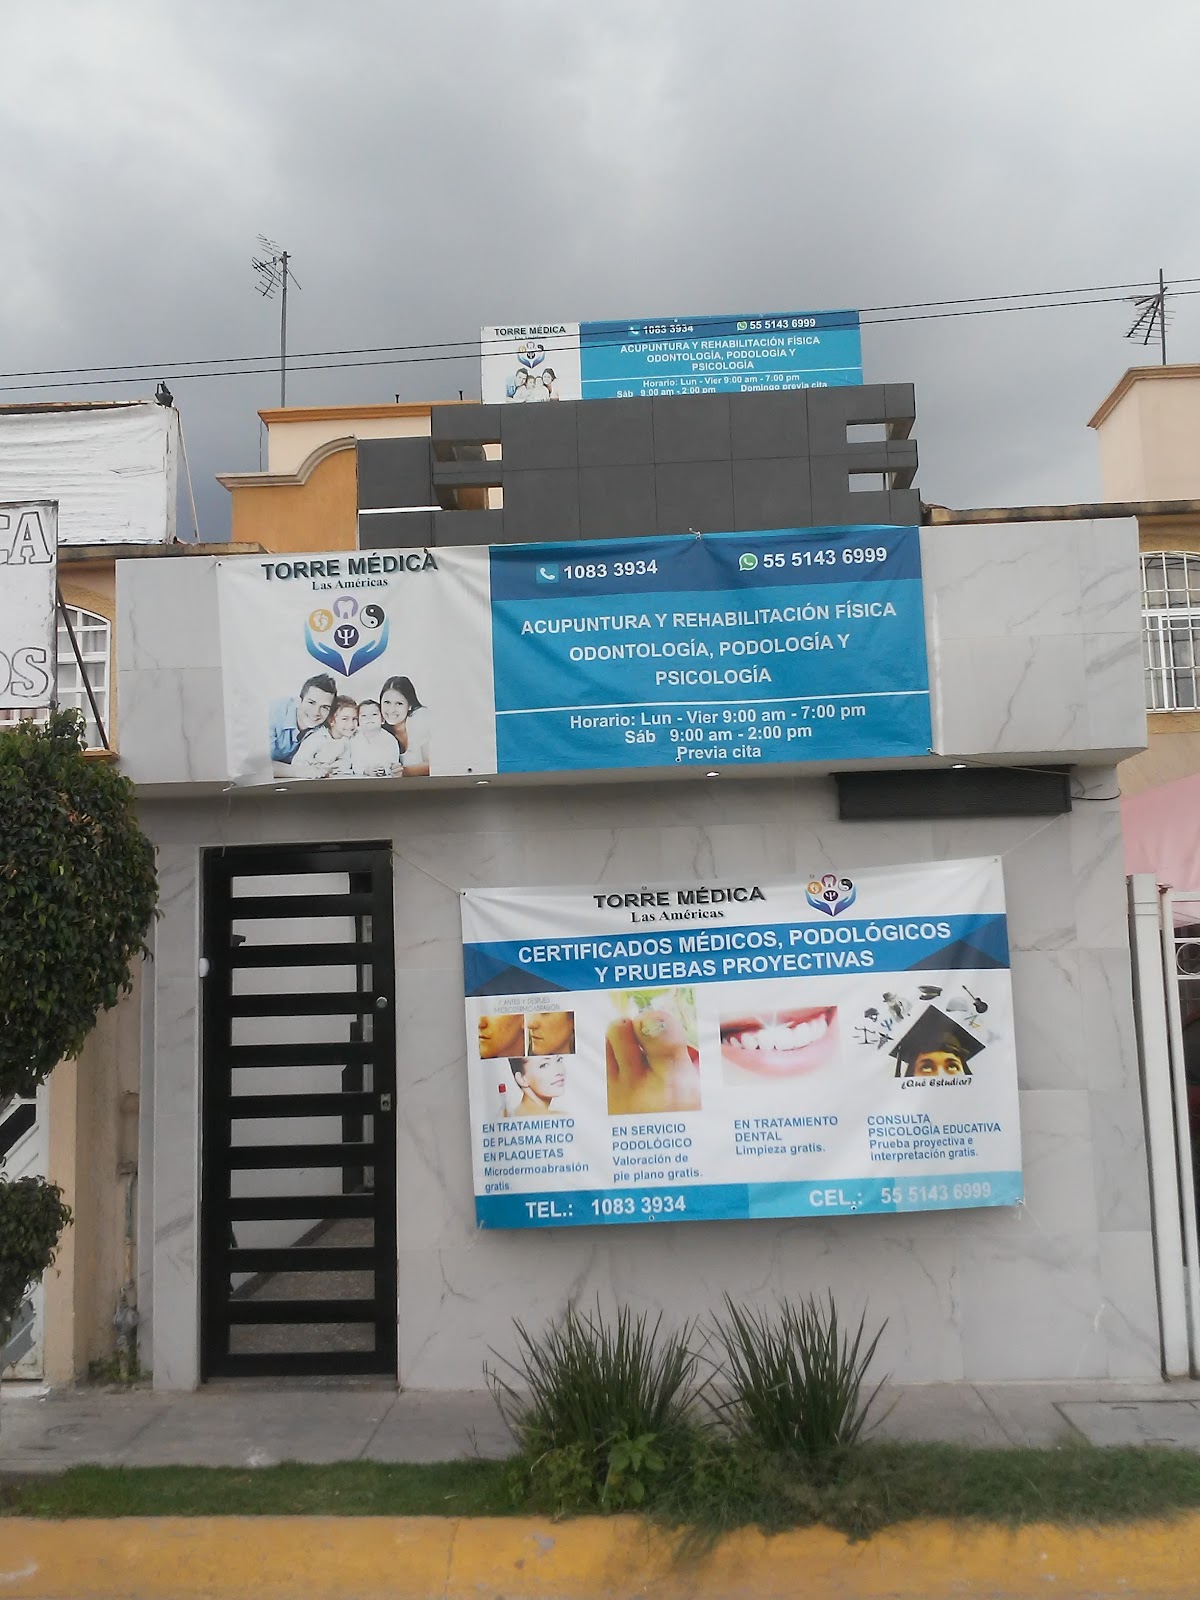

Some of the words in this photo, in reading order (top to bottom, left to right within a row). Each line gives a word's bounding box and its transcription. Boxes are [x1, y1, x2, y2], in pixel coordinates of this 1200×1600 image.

[494, 327, 527, 336] TORRE
[529, 325, 566, 335] MÉDICA
[643, 325, 667, 335] 1083
[669, 324, 694, 333] 3934
[750, 321, 762, 330] 55
[764, 320, 789, 329] 5143
[791, 318, 816, 328] 6999
[620, 342, 690, 354] ACUPUNTURA
[691, 341, 698, 350] Y
[701, 336, 785, 349] REHABILITACIÓN
[787, 335, 821, 345] FÍSICA
[647, 352, 724, 363] ODONTOLOGÍA,
[726, 349, 787, 359] PODOLOGÍA
[788, 348, 796, 357] Y
[692, 360, 754, 371] PSICOLOGÍA
[643, 379, 678, 388] Horario:
[680, 378, 697, 386] Lun
[705, 376, 721, 384] Vier
[724, 375, 743, 384] 9:00
[765, 374, 784, 382] 7:00
[786, 375, 800, 383] pm
[616, 390, 634, 398] Sáb
[681, 387, 700, 395] 2:00
[763, 552, 786, 569] 55
[791, 549, 837, 567] 5143
[842, 547, 888, 565] 6999
[261, 558, 341, 580] TORRE
[348, 552, 438, 576] MÉDICA
[563, 562, 607, 580] 1083
[613, 559, 658, 577] 3934
[312, 581, 332, 591] Las
[335, 577, 388, 589] Américas
[521, 613, 651, 636] ACUPUNTURA
[655, 612, 667, 628] Y
[672, 602, 830, 628] REHABILITACIÓN
[835, 599, 897, 620] FÍSICA
[569, 640, 714, 662] ODONTOLOGÍA,
[719, 633, 834, 657] PODOLOGÍA
[836, 633, 850, 649] Y
[655, 664, 772, 686] PSICOLOGÍA
[570, 712, 635, 729] Horario:
[640, 711, 672, 727] Lun
[686, 709, 719, 725] Vier
[723, 708, 757, 724] 9:00
[760, 710, 786, 723] am
[801, 705, 836, 721] 7:00
[841, 706, 867, 723] pm
[625, 728, 656, 745] Sáb
[670, 727, 704, 743] 9:00
[708, 729, 734, 742] am
[748, 725, 782, 741] 2:00
[786, 727, 813, 744] pm
[677, 745, 727, 760] Previa
[732, 744, 761, 758] cita
[593, 891, 670, 909] TORRE
[677, 886, 766, 905] MÉDICA
[630, 912, 655, 923] Las
[659, 909, 724, 921] Américas
[518, 940, 673, 965] CERTIFICADOS
[678, 930, 783, 954] MÉDICOS,
[789, 921, 952, 946] PODOLÓGICOS
[594, 966, 607, 984] Y
[614, 959, 716, 982] PRUEBAS
[722, 949, 875, 975] PROYECTIVAS
[503, 998, 520, 1006] ANTES
[901, 1078, 926, 1090] ¿Qué
[482, 1123, 495, 1133] EN
[497, 1118, 575, 1132] TRATAMIENTO
[734, 1118, 751, 1130] EN
[754, 1115, 839, 1129] TRATAMIENTO
[867, 1113, 931, 1126] CONSULTA
[612, 1127, 627, 1137] EN
[631, 1123, 686, 1135] SERVICIO
[735, 1131, 782, 1143] DENTAL
[868, 1122, 941, 1137] PSICOLOGÍA
[943, 1122, 1002, 1135] EDUCATIVA
[483, 1138, 496, 1148] DE
[498, 1135, 542, 1147] PLASMA
[545, 1133, 574, 1144] RICO
[612, 1137, 692, 1151] PODOLÓGICO
[869, 1139, 910, 1149] Prueba
[913, 1137, 965, 1150] proyectiva
[967, 1137, 973, 1145] e
[484, 1152, 496, 1162] EN
[498, 1148, 564, 1161] PLAQUETAS
[735, 1144, 787, 1157] Limpieza
[790, 1142, 826, 1155] gratis.
[948, 1148, 978, 1160] gratis.
[612, 1155, 672, 1166] Valoración
[675, 1153, 689, 1163] de
[484, 1162, 589, 1177] Microdermoabrasión
[613, 1171, 631, 1183] pie
[634, 1170, 665, 1183] plano
[667, 1168, 703, 1181] gratis.
[809, 1189, 863, 1207] CEL.:
[881, 1187, 902, 1204] 55
[908, 1184, 948, 1202] 5143
[953, 1182, 992, 1200] 6999
[525, 1201, 573, 1219] TEL.:
[591, 1198, 636, 1216] 1083
[641, 1195, 686, 1213] 3934
